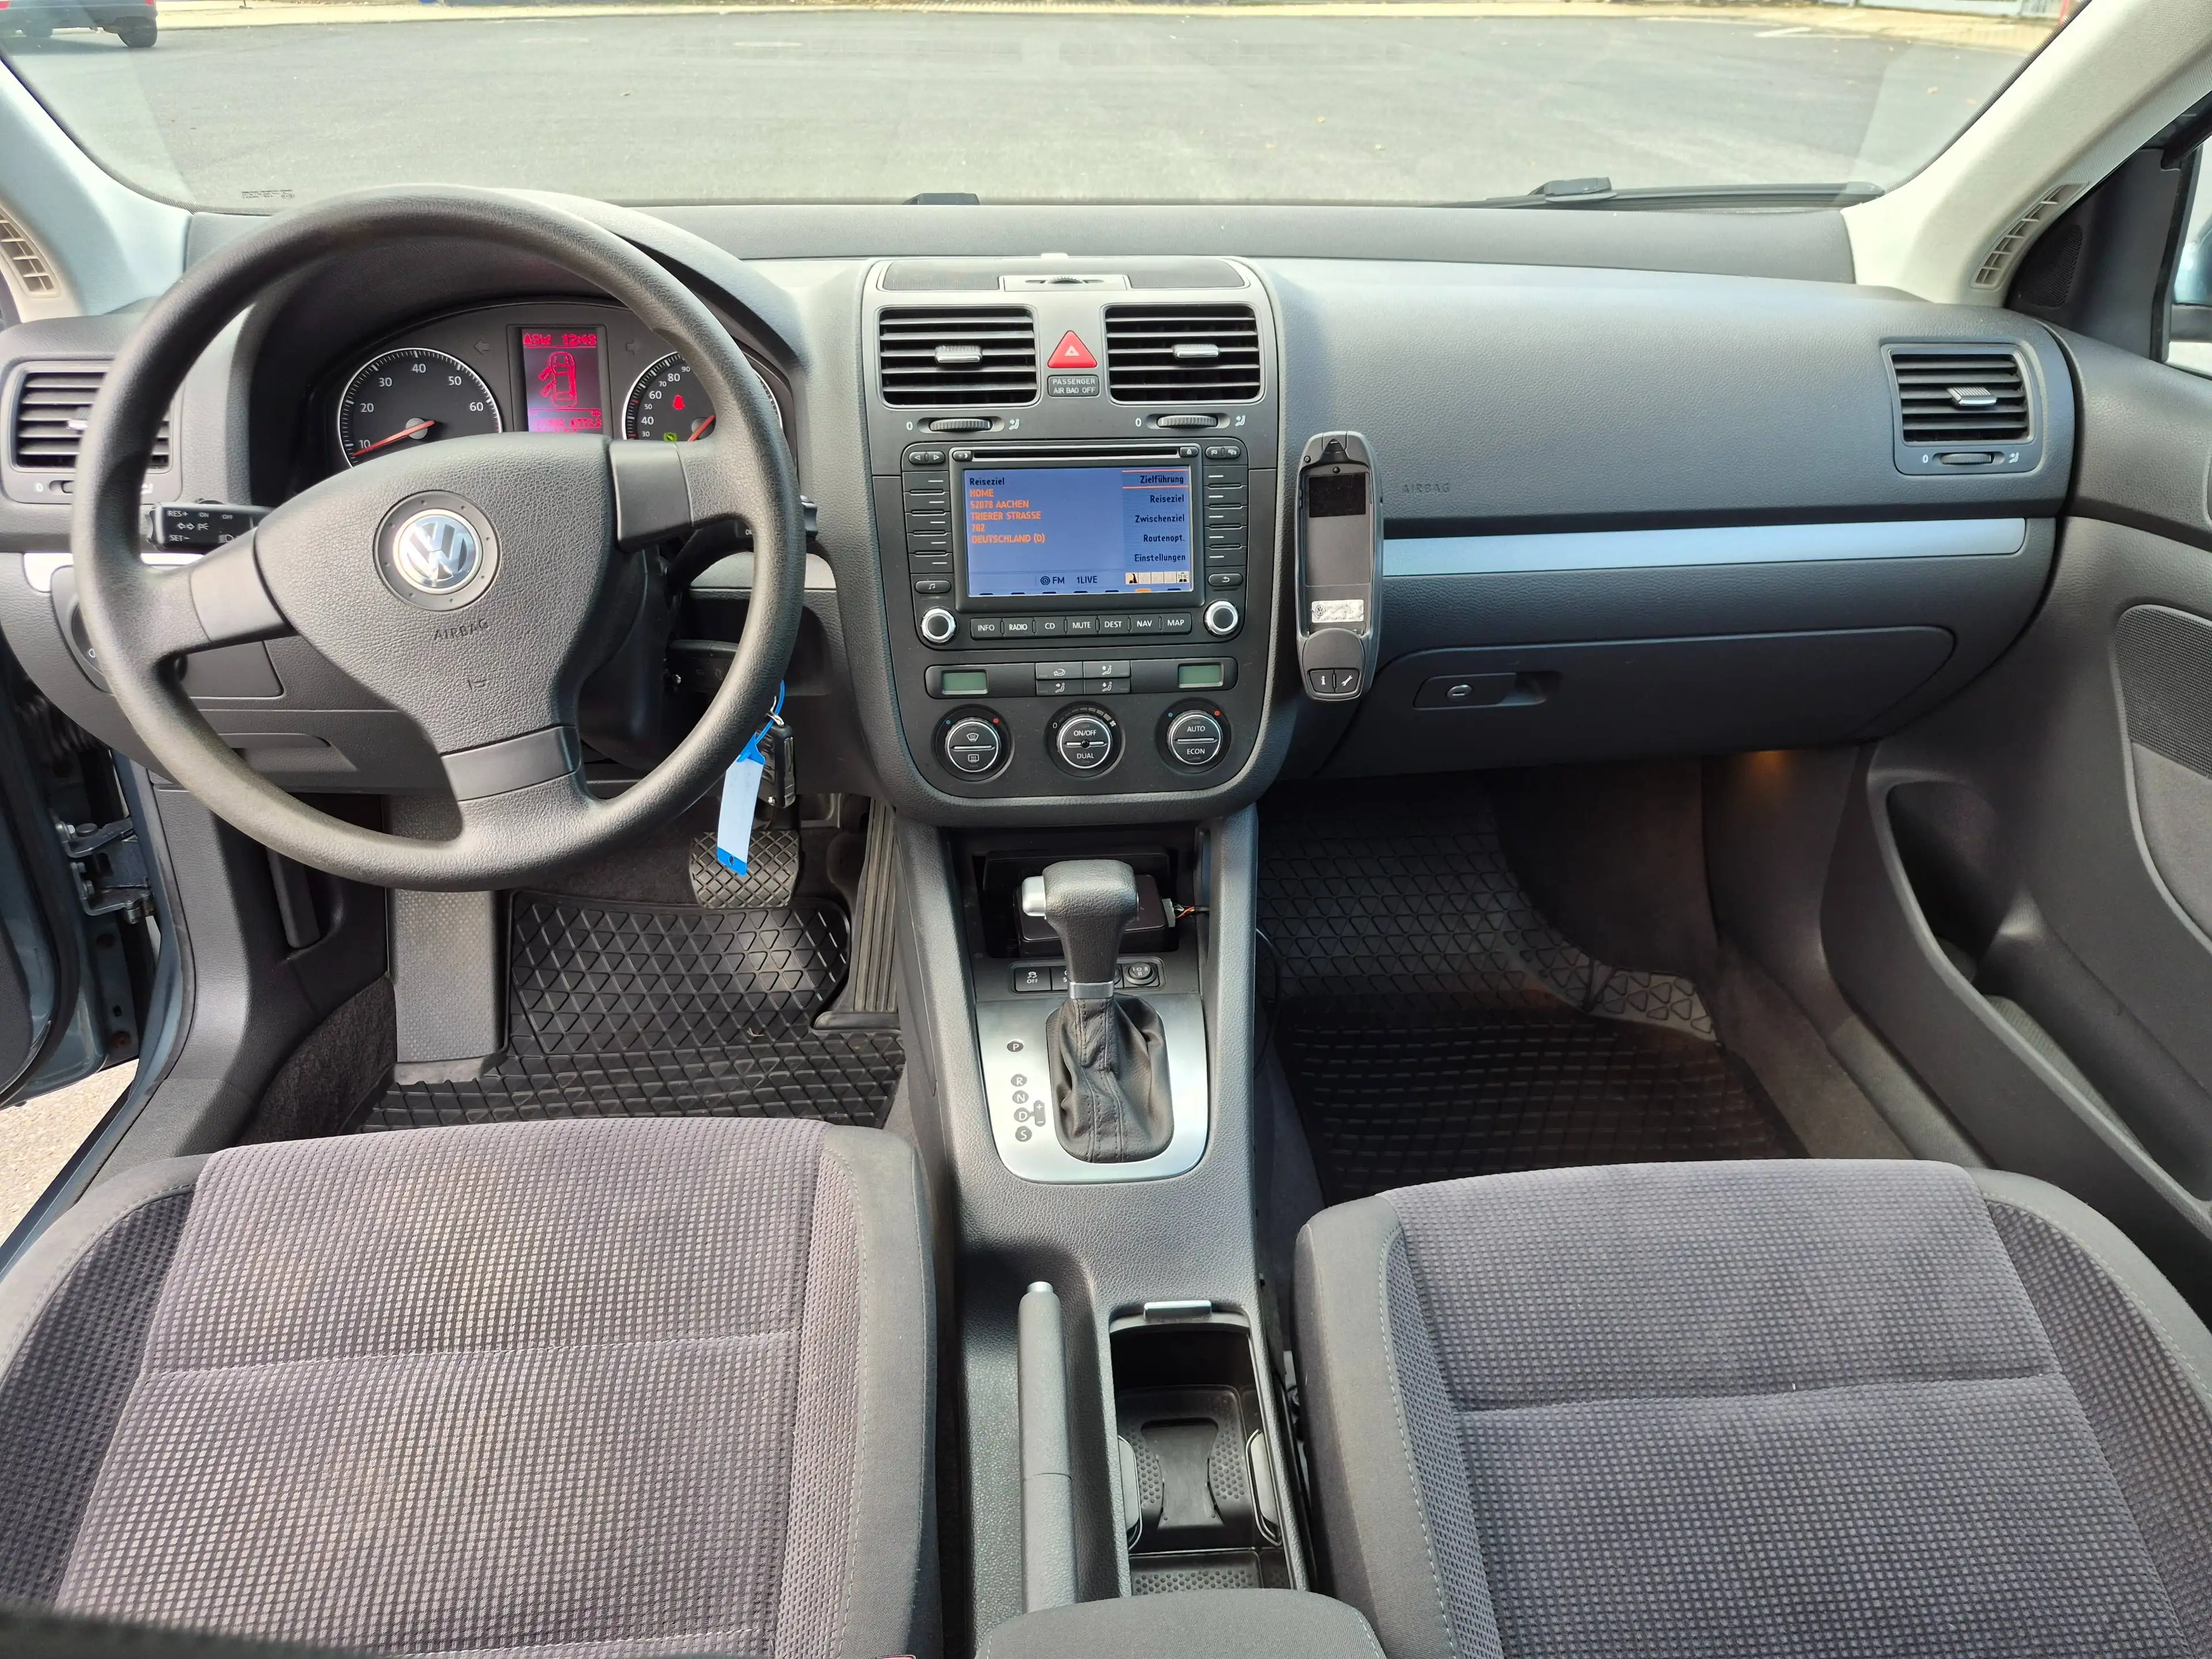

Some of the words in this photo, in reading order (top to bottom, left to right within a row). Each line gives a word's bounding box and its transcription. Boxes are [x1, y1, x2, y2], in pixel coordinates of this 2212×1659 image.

[412, 363, 426, 373] 40
[379, 377, 392, 387] 30
[448, 376, 461, 385] 50
[668, 373, 680, 382] 80
[649, 391, 662, 399] 60
[361, 403, 374, 412] 20
[470, 402, 483, 411] 60
[641, 416, 654, 425] 40
[1135, 419, 1142, 427] 0
[906, 422, 912, 431] 0
[359, 440, 371, 448] 10
[1923, 454, 1929, 464] 0
[969, 477, 1005, 486] Reiseziel
[1140, 475, 1184, 484] Zielführung
[969, 488, 994, 497] HOME
[1404, 483, 1450, 493] AIRBAG
[1150, 494, 1184, 503] Reiseziel
[970, 501, 994, 509] 52078
[996, 500, 1030, 509] AACHEN
[971, 512, 1003, 521] TRIERER
[1006, 511, 1041, 520] STRASSE
[1135, 514, 1185, 523] Zwischenziel
[972, 524, 986, 532] 702
[972, 535, 1031, 544] DEUTSCHLAND
[1033, 533, 1046, 544] (D)
[1143, 534, 1185, 543] Routenopt.
[1135, 554, 1185, 562] Einstellungen
[1052, 576, 1065, 584] FM
[1077, 575, 1098, 584] 1LIVE
[1073, 621, 1091, 629] MUTE
[1104, 620, 1123, 628] DEST
[1167, 619, 1184, 627] MAP
[433, 618, 489, 641] AIRBAG
[1016, 1077, 1023, 1085] R
[1017, 1094, 1025, 1103] N
[1018, 1111, 1028, 1120] D
[1021, 1130, 1027, 1140] S
